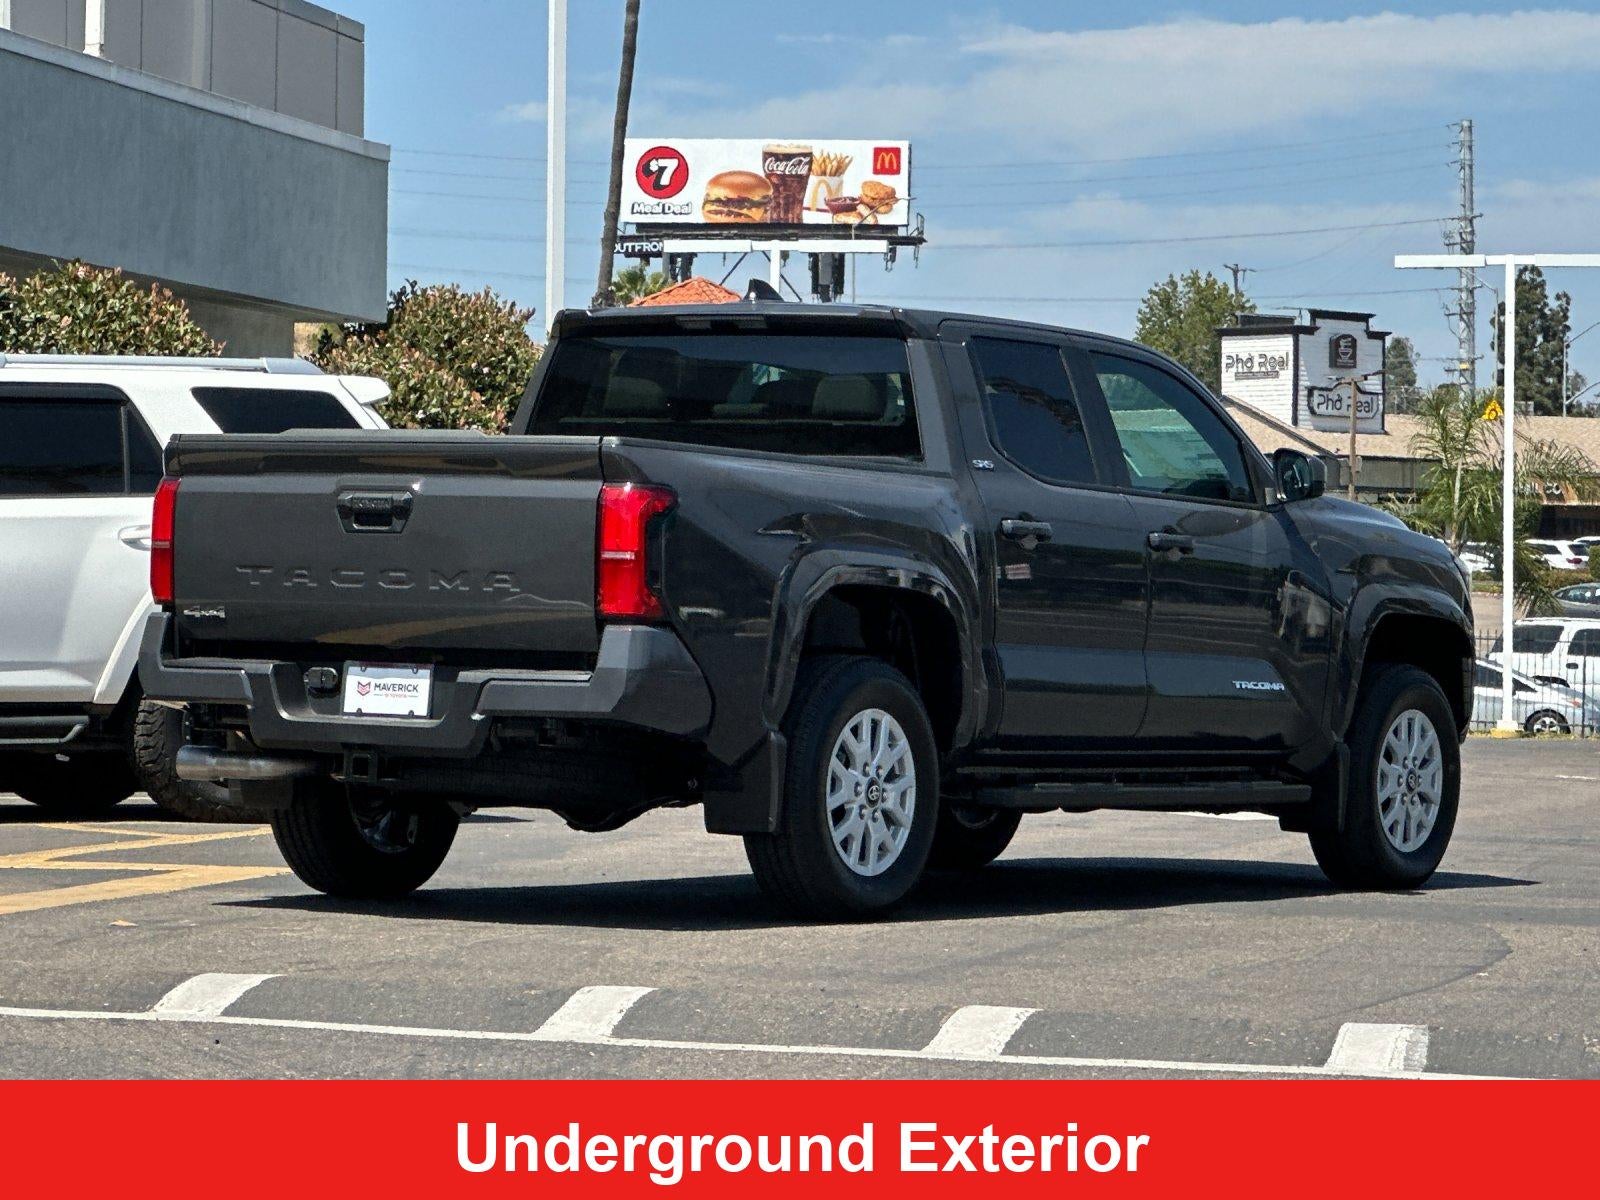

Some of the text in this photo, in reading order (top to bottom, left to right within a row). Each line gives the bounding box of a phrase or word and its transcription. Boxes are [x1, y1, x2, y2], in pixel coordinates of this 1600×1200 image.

[631, 202, 692, 215] Meal Deal
[1258, 351, 1290, 371] Real
[236, 565, 520, 593] TACOMA
[373, 682, 419, 694] MAVERICK
[1232, 680, 1285, 691] TACOMA
